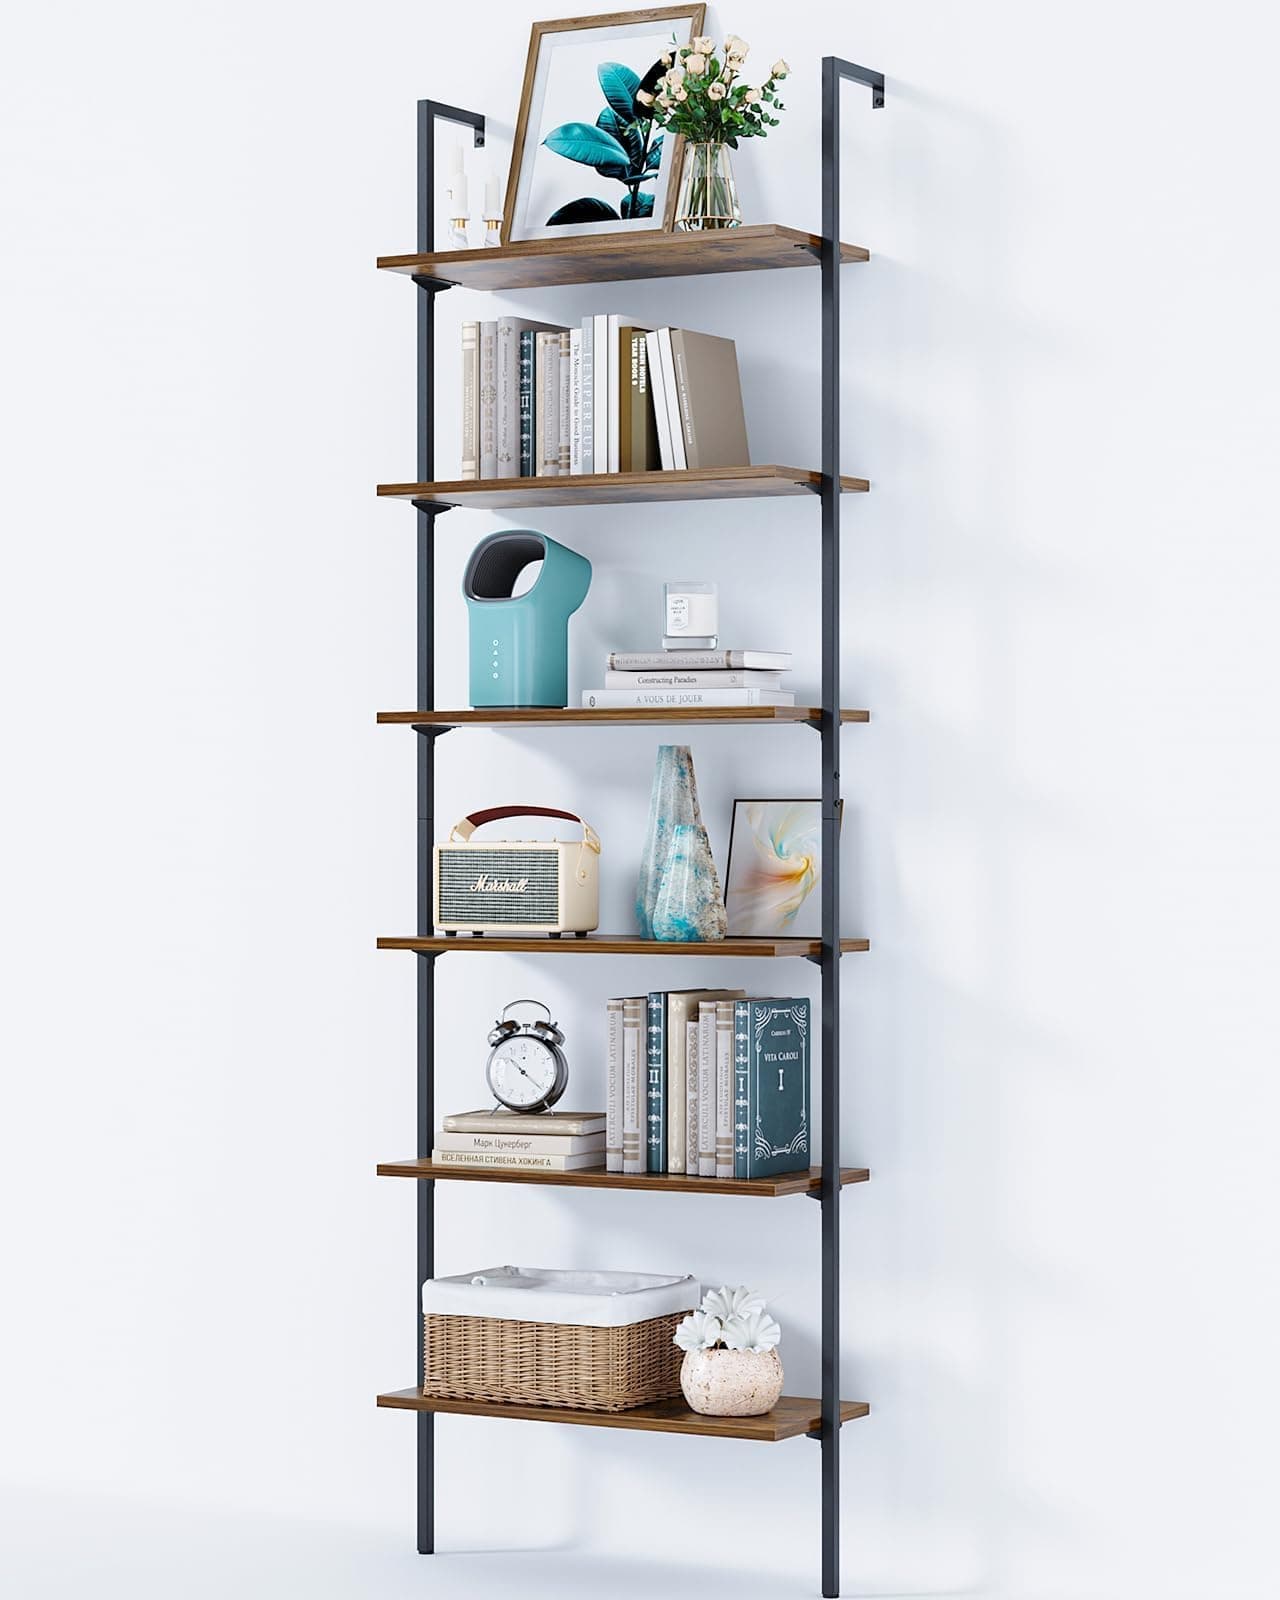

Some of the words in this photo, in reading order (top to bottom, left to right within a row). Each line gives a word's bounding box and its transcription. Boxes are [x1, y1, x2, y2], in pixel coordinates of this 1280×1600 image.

[637, 676, 673, 685] Constructing
[644, 695, 664, 704] VOUS
[666, 695, 677, 704] DE
[678, 694, 704, 704] JOUER
[470, 874, 529, 893] Marshall
[609, 1012, 617, 1062] LATINARUM
[701, 1015, 709, 1066] LATINARUM
[609, 1065, 617, 1097] VOCUM
[701, 1068, 709, 1101] VOCUM
[473, 1138, 493, 1149] Марк
[441, 1153, 485, 1163] ВСЕЛЕННАЯ
[485, 1154, 517, 1164] СТИВЕНА
